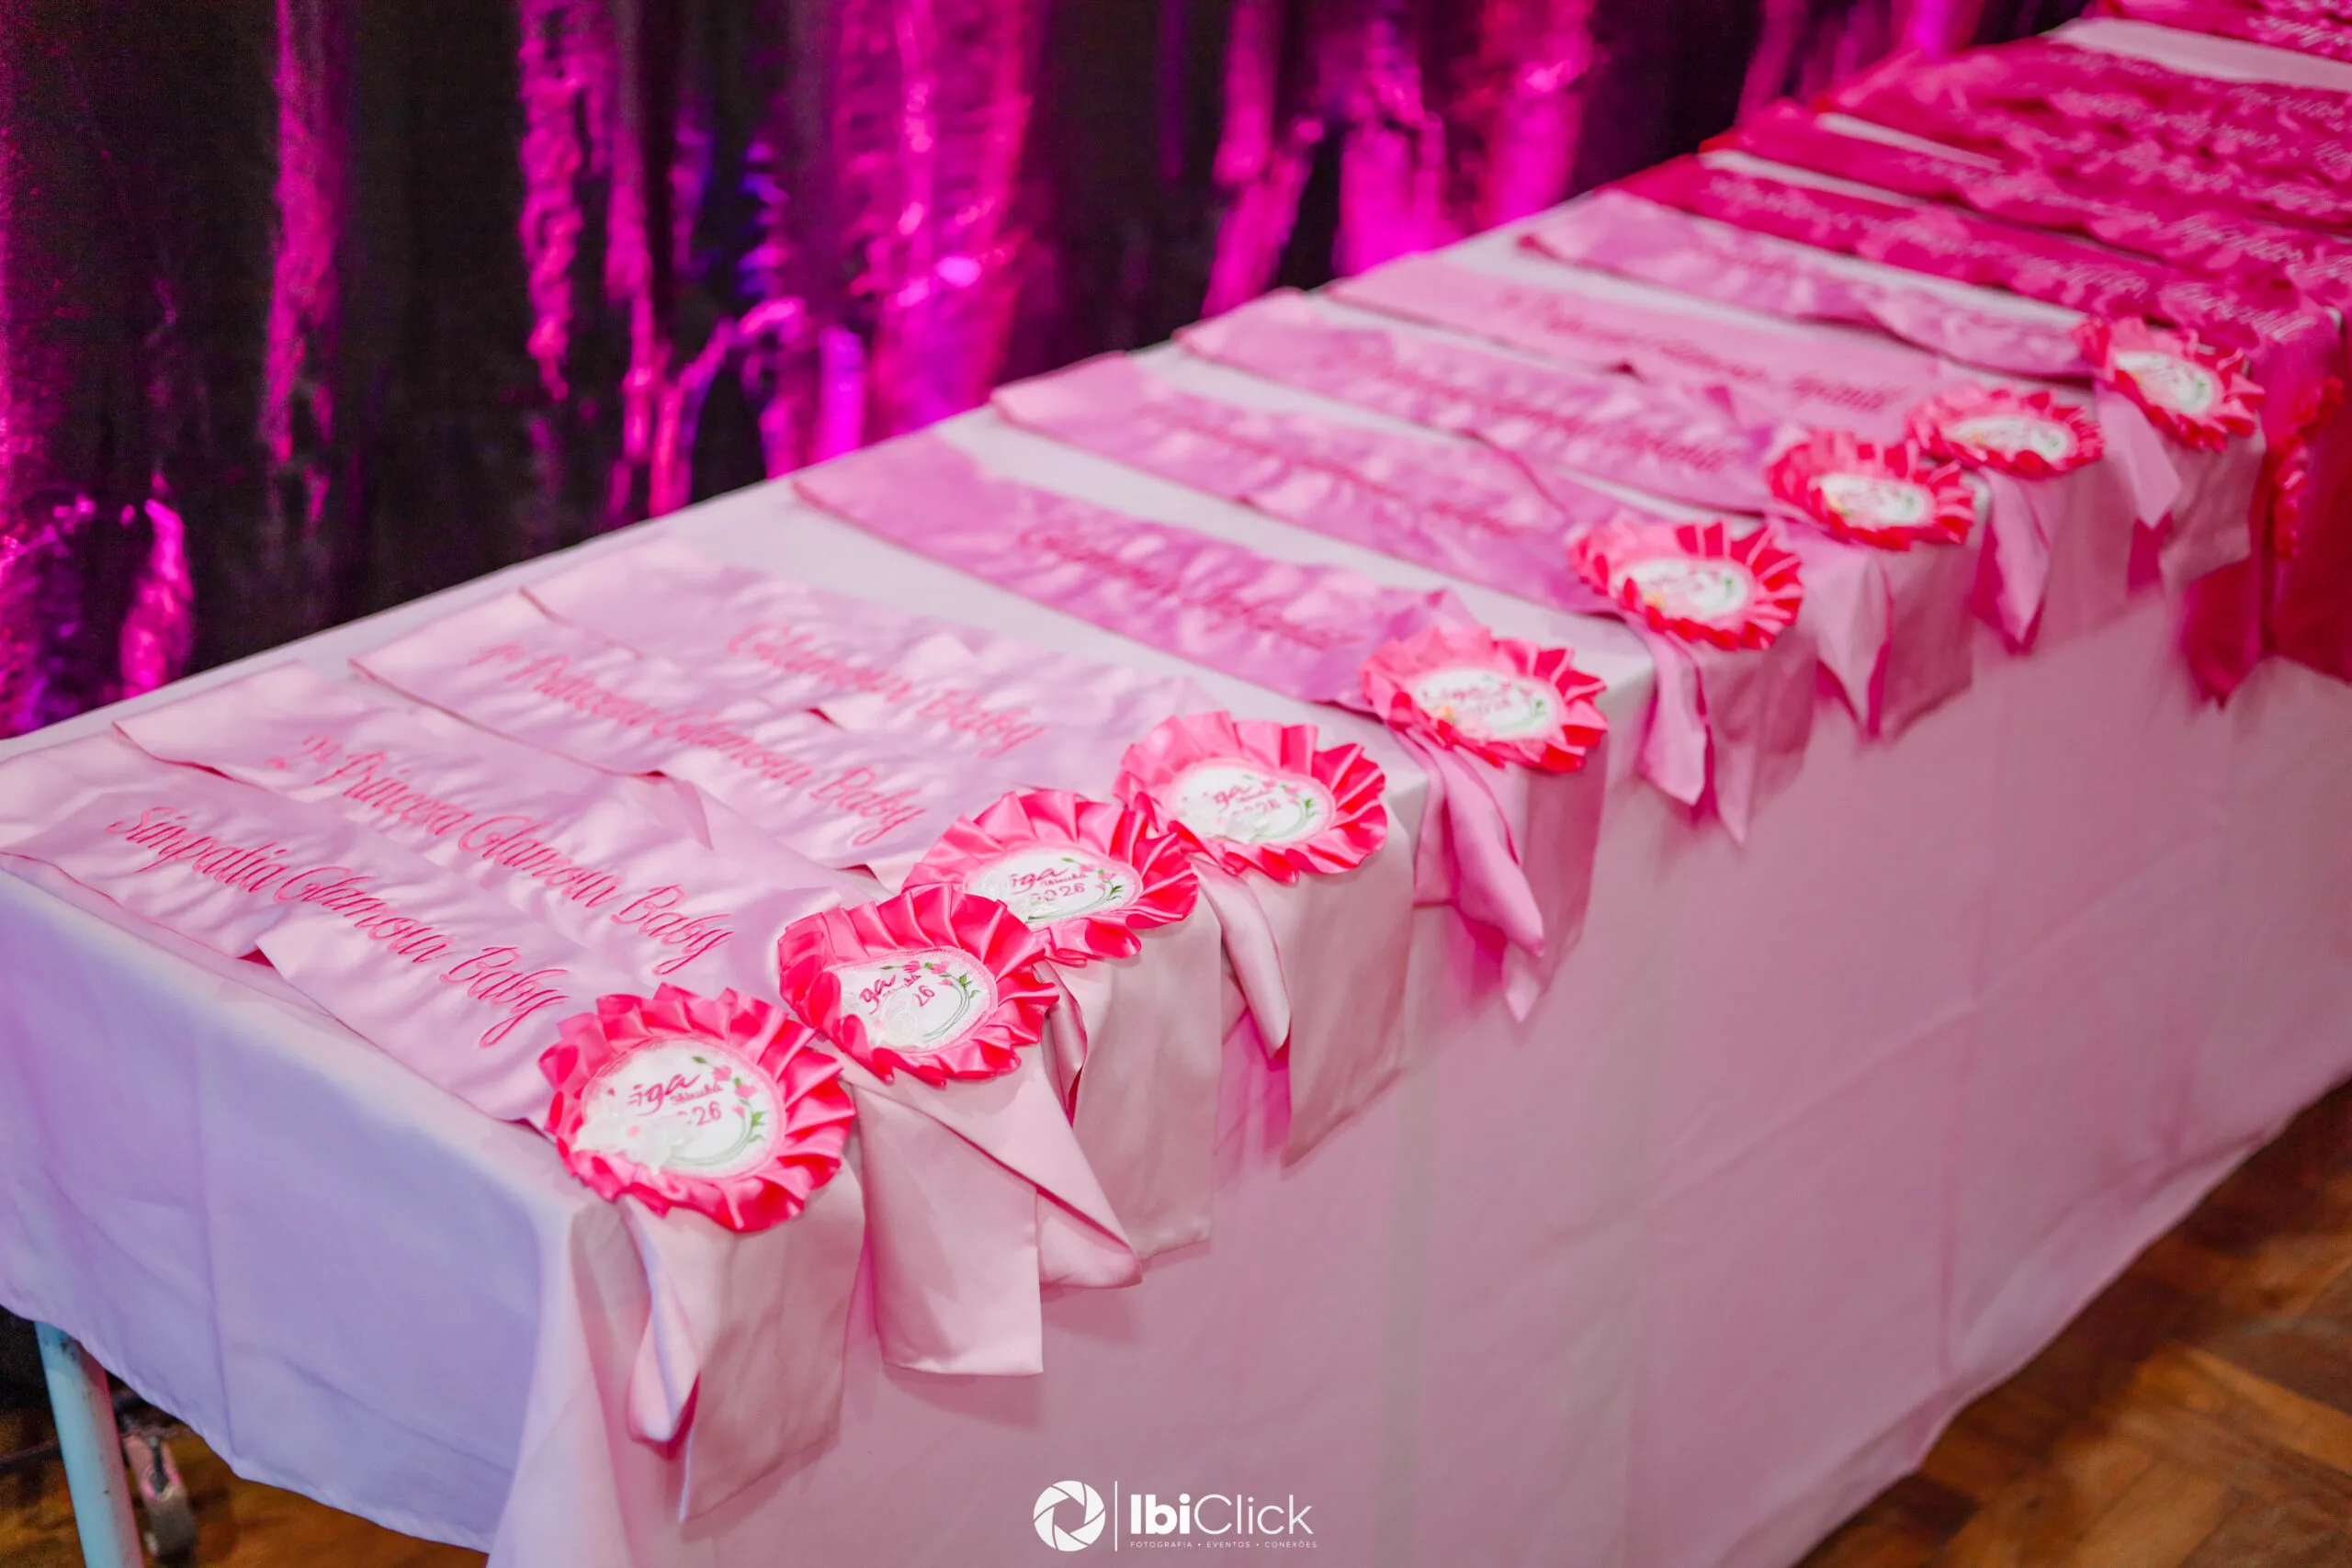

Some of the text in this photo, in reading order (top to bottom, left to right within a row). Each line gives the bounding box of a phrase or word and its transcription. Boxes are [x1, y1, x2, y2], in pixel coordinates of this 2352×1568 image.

[916, 690, 1049, 760] Baby
[809, 765, 931, 848] Baby
[458, 813, 626, 909] Glamour
[610, 883, 735, 976] Baby
[1009, 867, 1069, 896] iga
[105, 806, 571, 1049] Simpatia Glamour Baby
[912, 984, 936, 1008] 26
